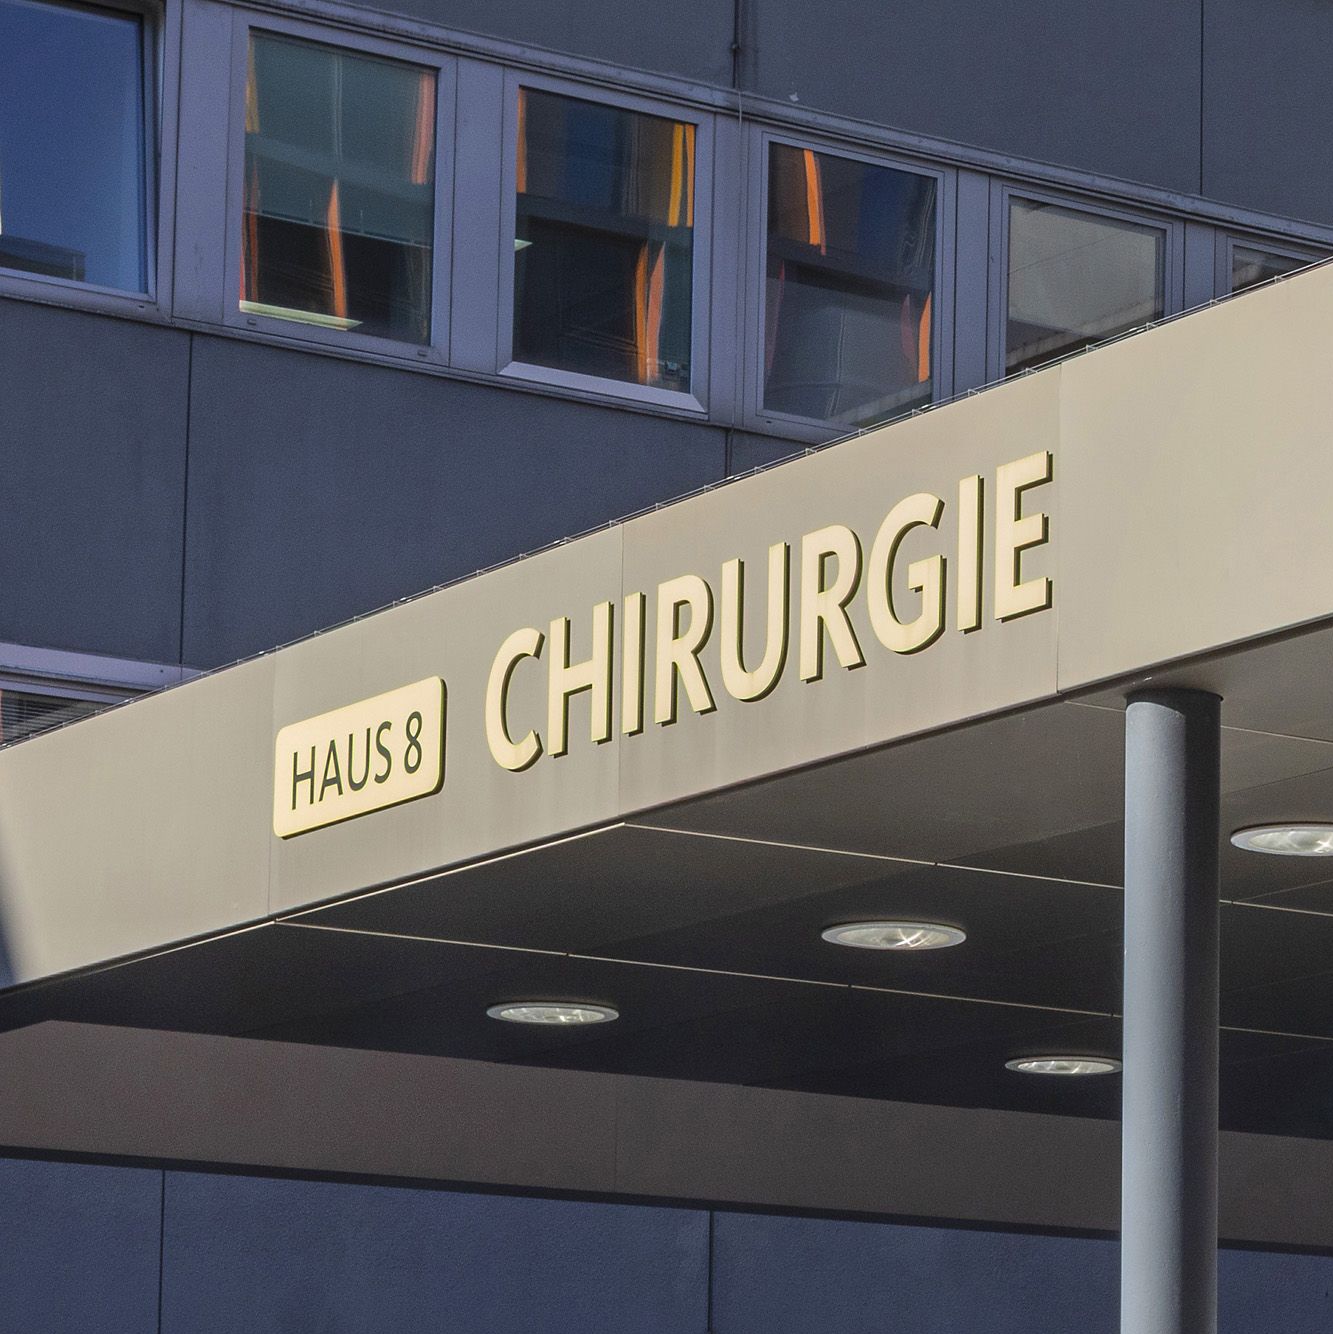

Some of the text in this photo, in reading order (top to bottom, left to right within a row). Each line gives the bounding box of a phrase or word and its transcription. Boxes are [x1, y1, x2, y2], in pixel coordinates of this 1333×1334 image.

[485, 449, 1054, 773] CHIRURGIE
[291, 710, 425, 811] HAUS 8
